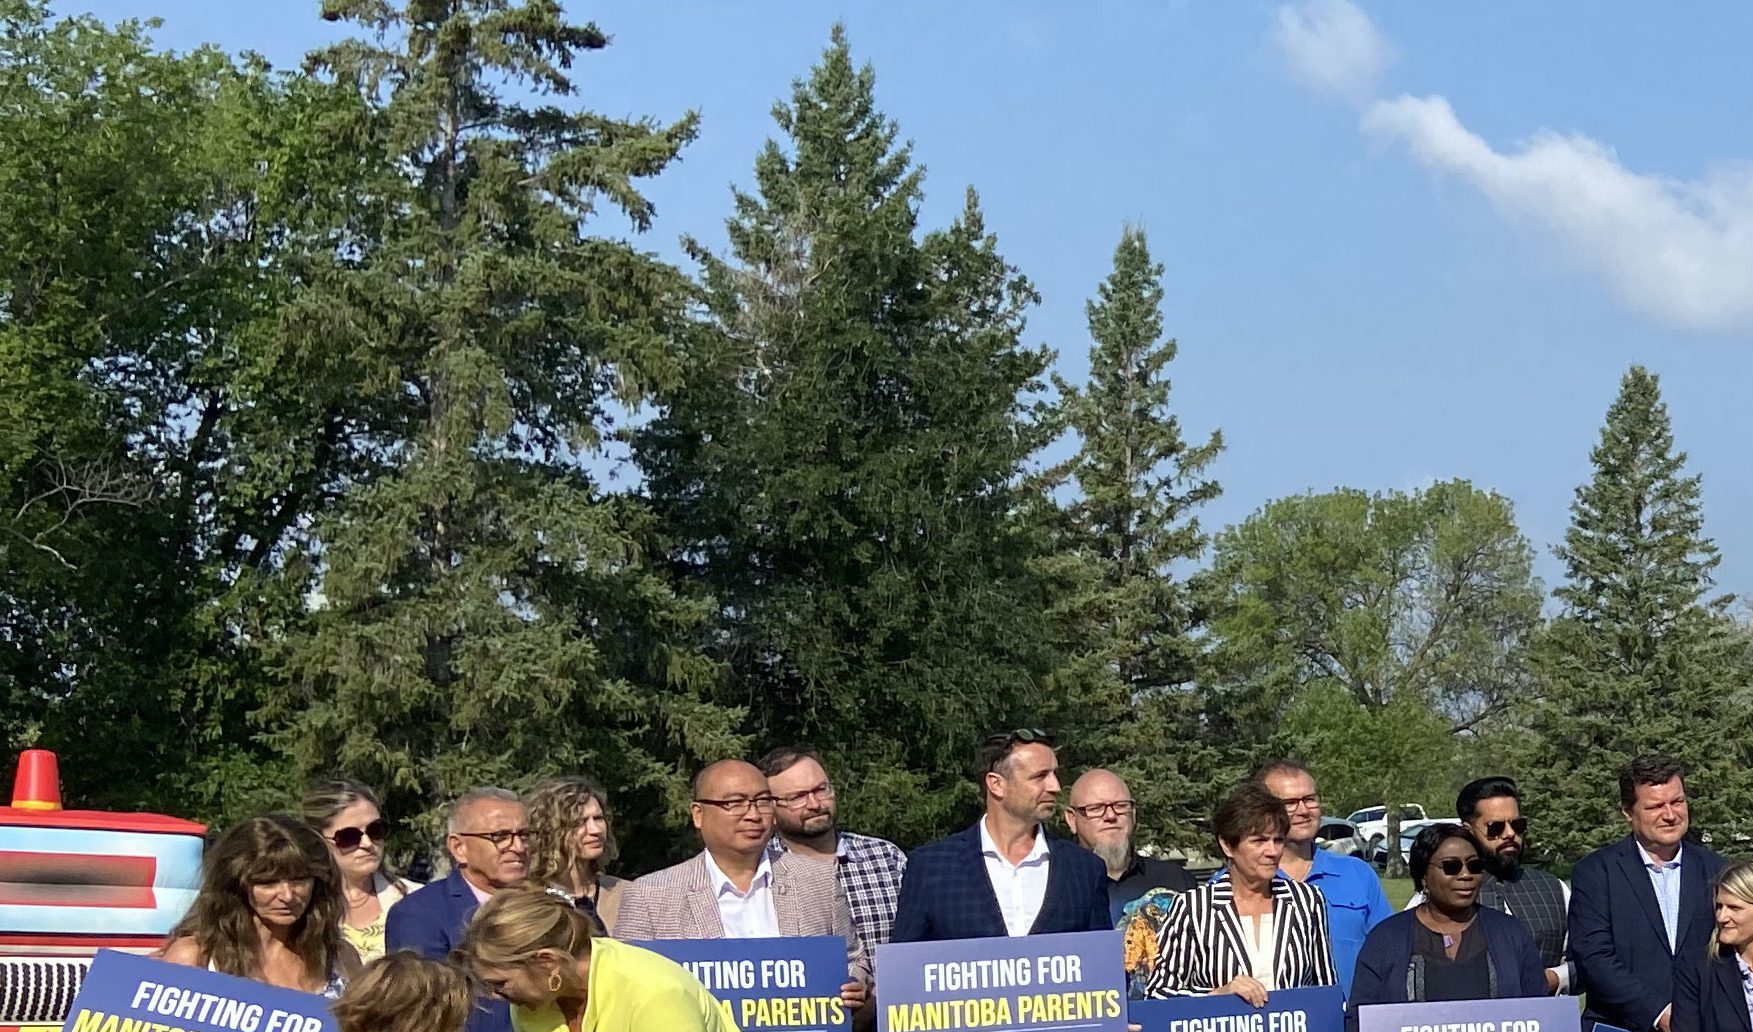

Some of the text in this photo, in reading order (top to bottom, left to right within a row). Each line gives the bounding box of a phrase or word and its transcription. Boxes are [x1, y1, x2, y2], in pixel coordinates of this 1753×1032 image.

[683, 959, 806, 989] TING FOR
[924, 955, 1082, 992] FIGHTING FOR
[131, 981, 264, 1032] FIGHTING
[742, 997, 845, 1027] PARENTS
[888, 990, 1121, 1032] MANITOBA PARENTS
